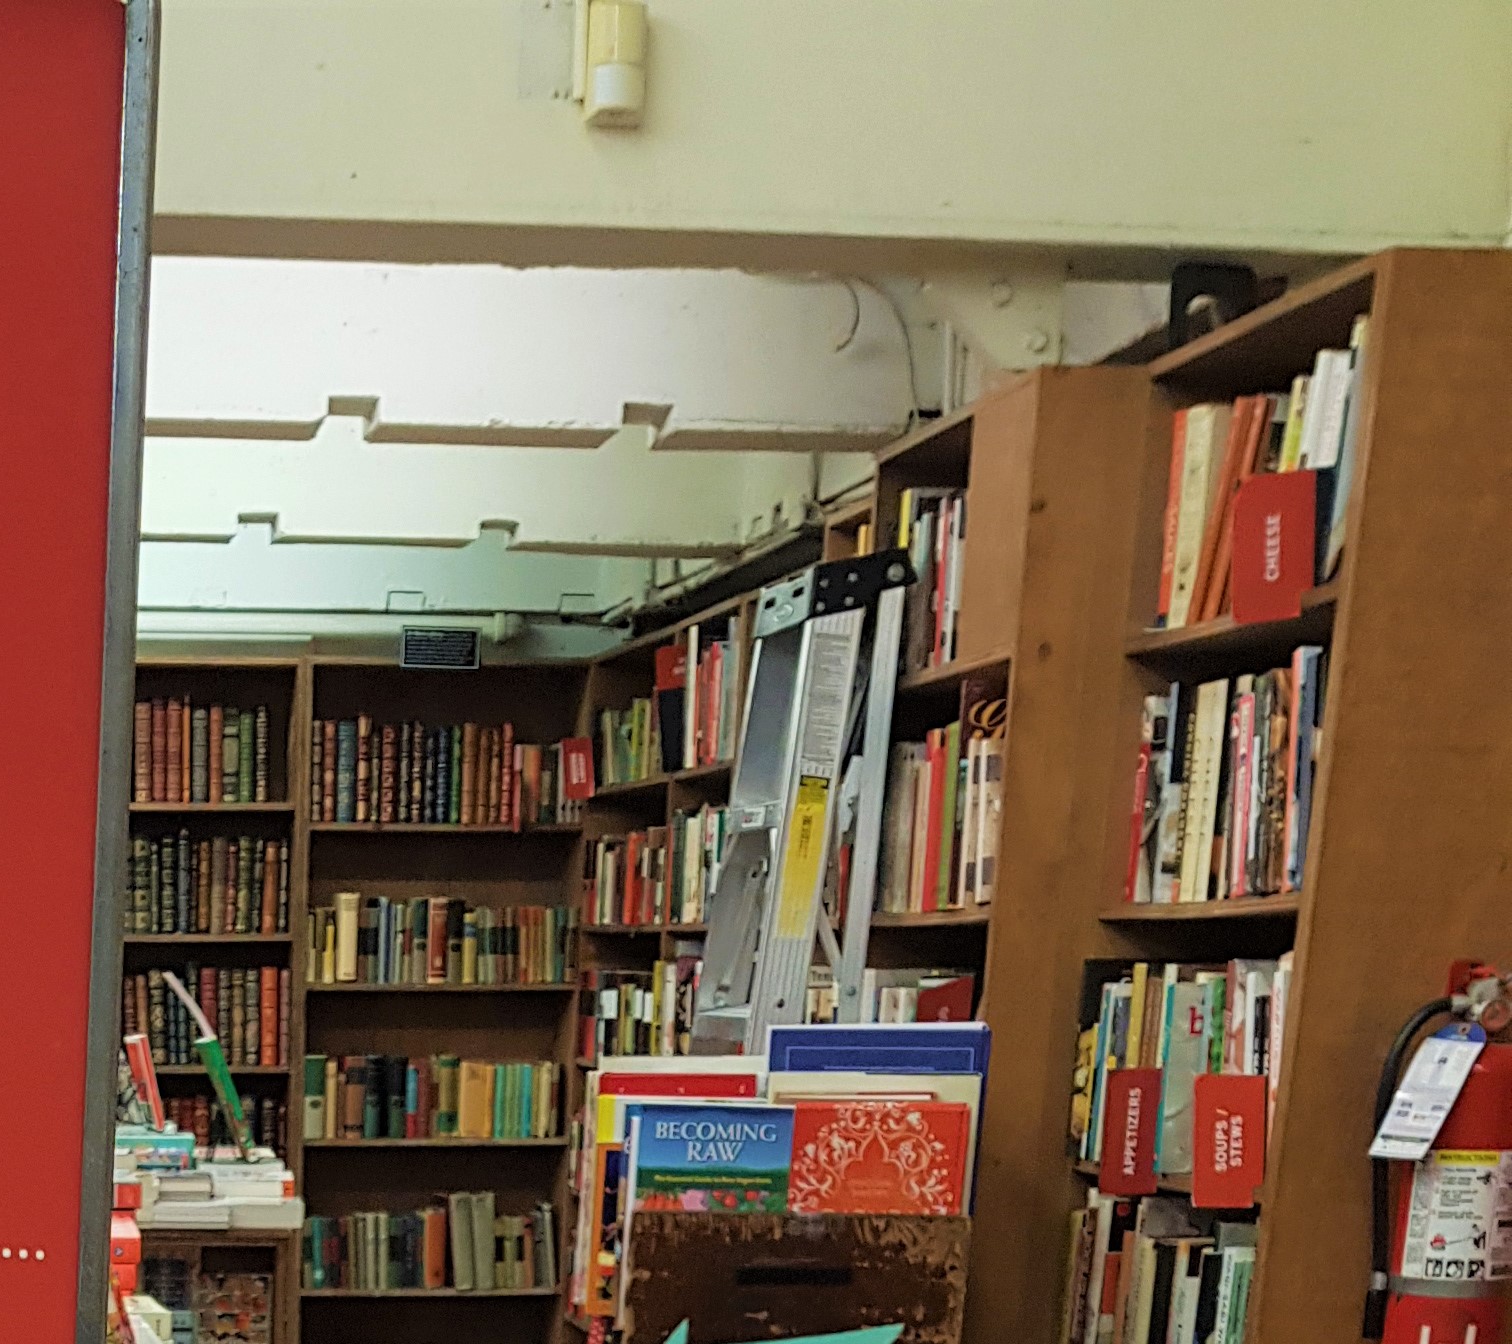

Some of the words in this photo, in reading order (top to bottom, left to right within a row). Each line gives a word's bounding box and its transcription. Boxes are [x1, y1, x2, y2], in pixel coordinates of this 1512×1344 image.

[1265, 512, 1281, 582] CHEESE
[656, 1122, 777, 1142] BECOMING
[688, 1142, 743, 1162] RAW
[1215, 1120, 1228, 1173] SOUPS
[1230, 1115, 1243, 1167] STEWS
